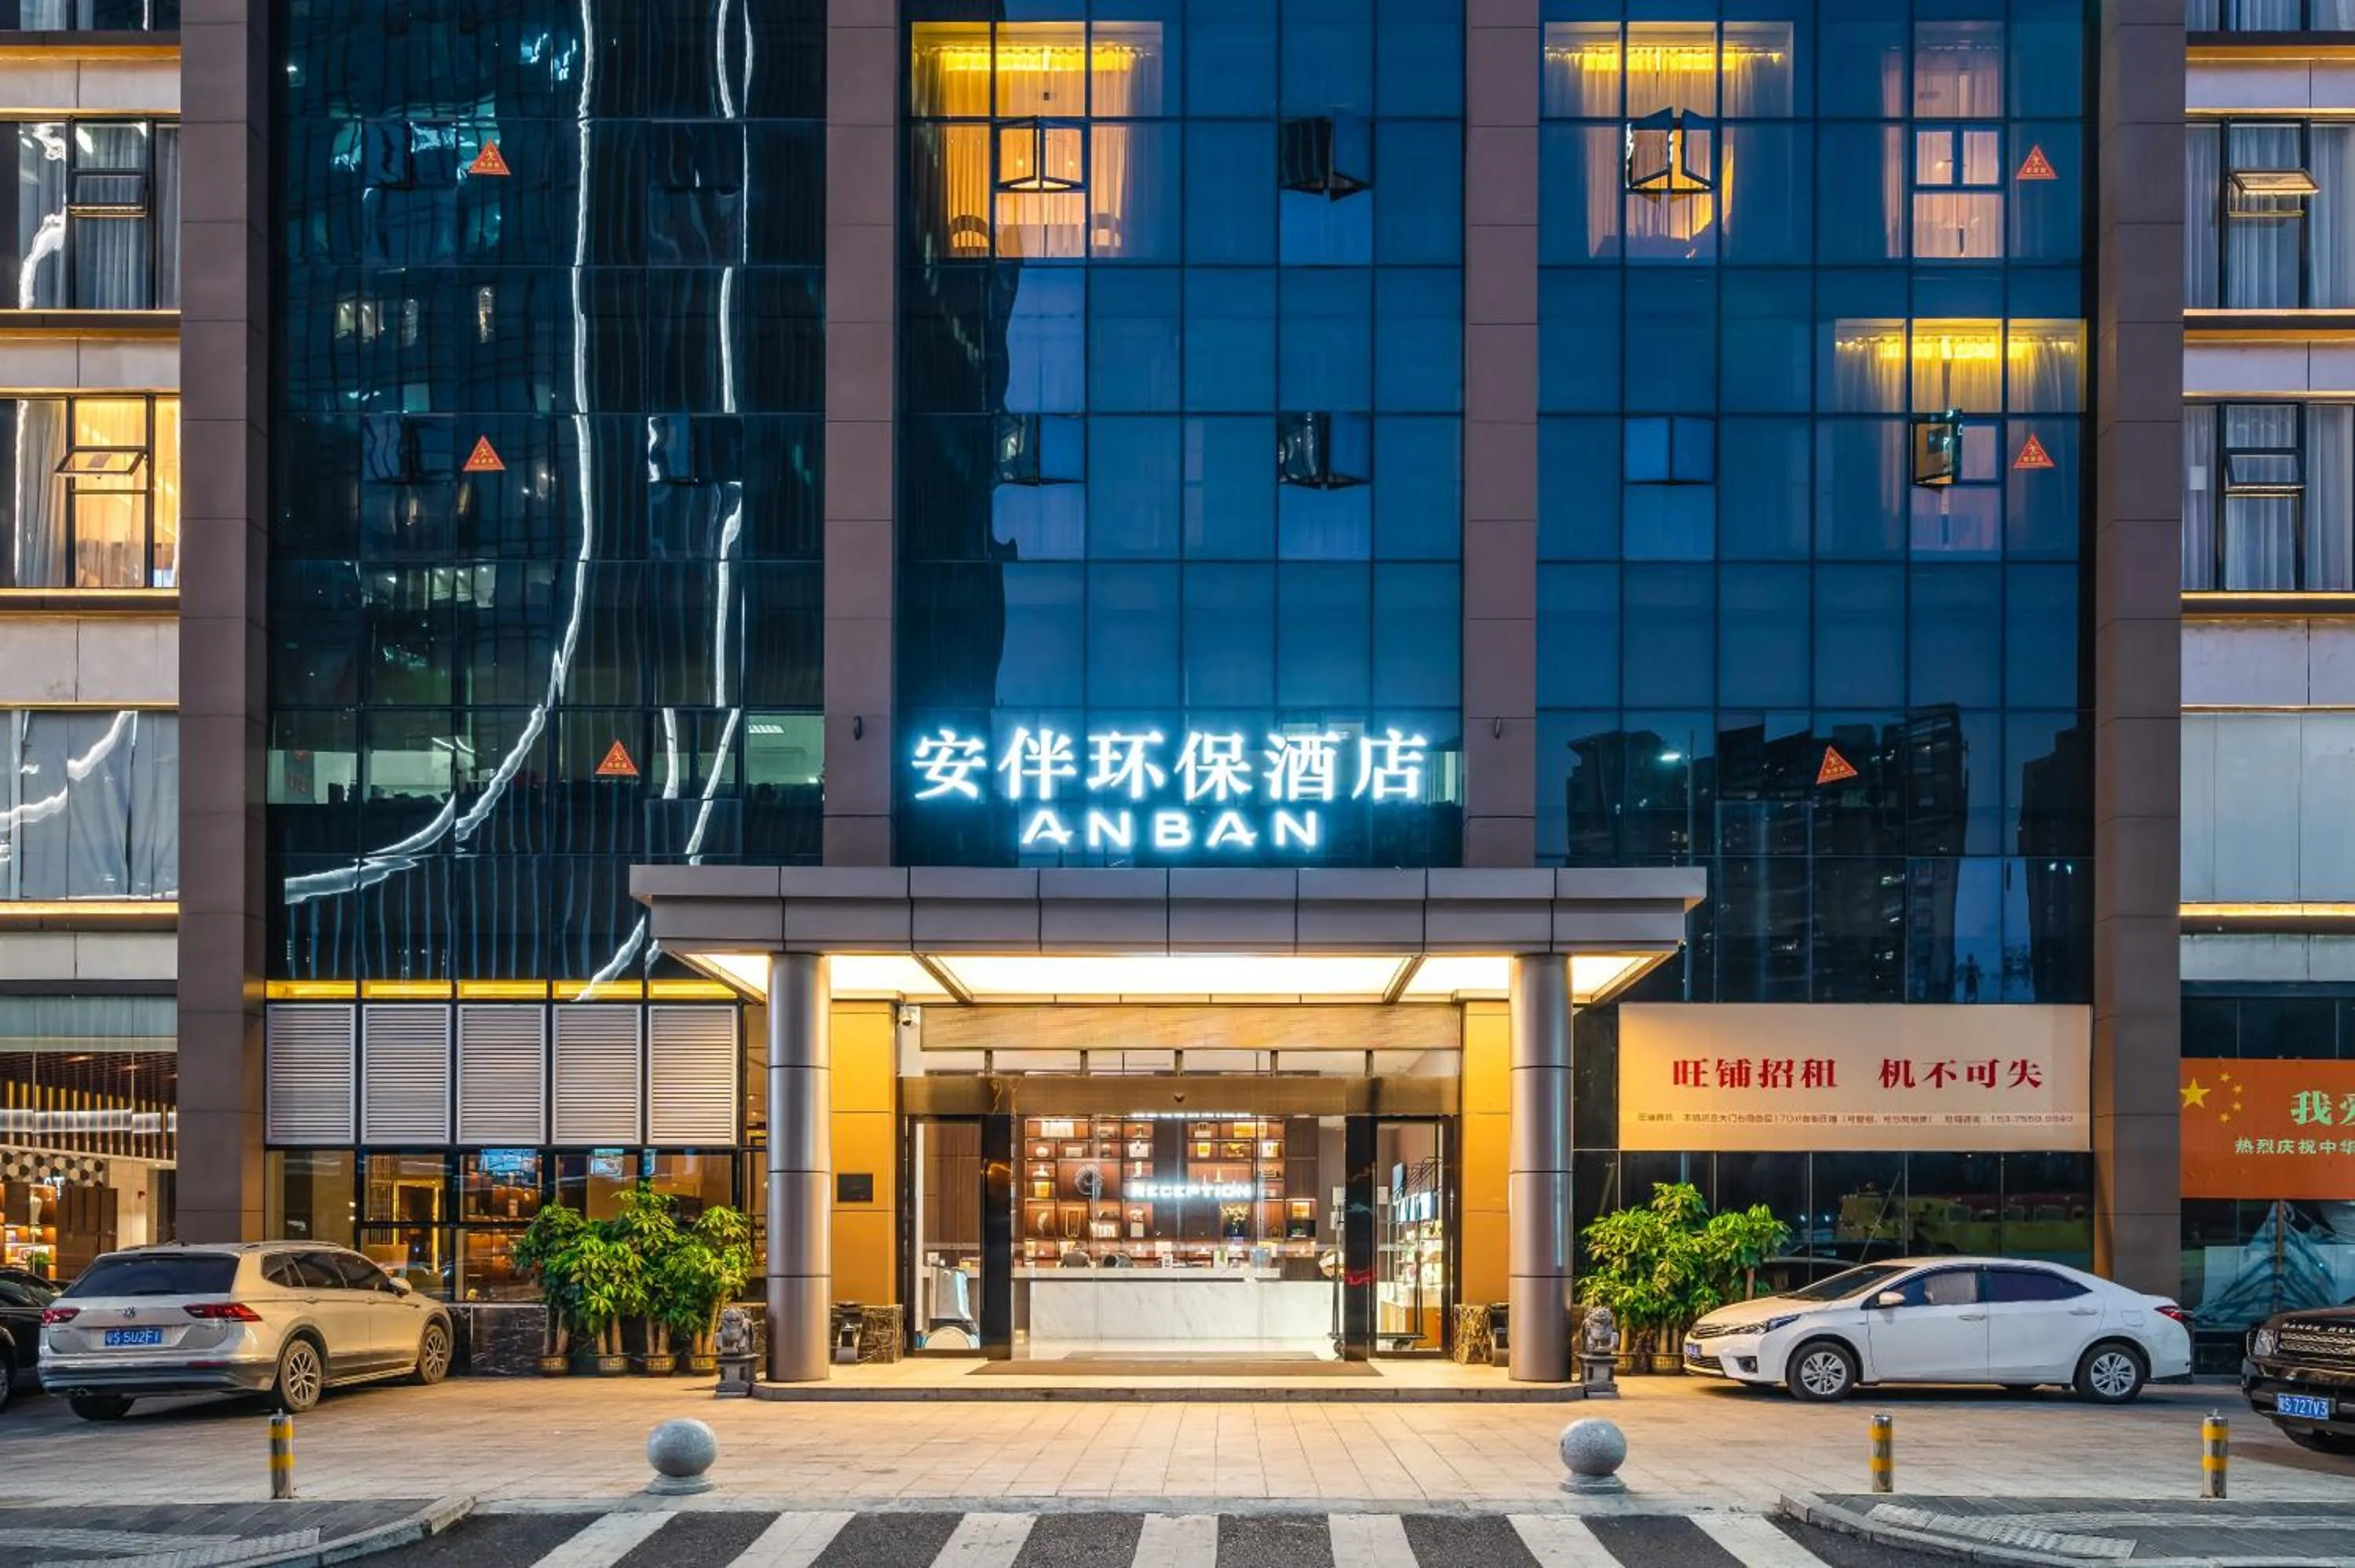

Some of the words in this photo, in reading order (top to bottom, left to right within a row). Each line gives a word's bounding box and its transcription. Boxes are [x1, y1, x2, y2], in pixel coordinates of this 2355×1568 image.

[911, 727, 1427, 800] 安伴环保酒店
[1022, 809, 1318, 848] ANBAN
[1673, 1058, 1838, 1089] 旺铺招租
[1878, 1058, 2043, 1089] 机不可失
[1130, 1183, 1251, 1198] RECEPTION
